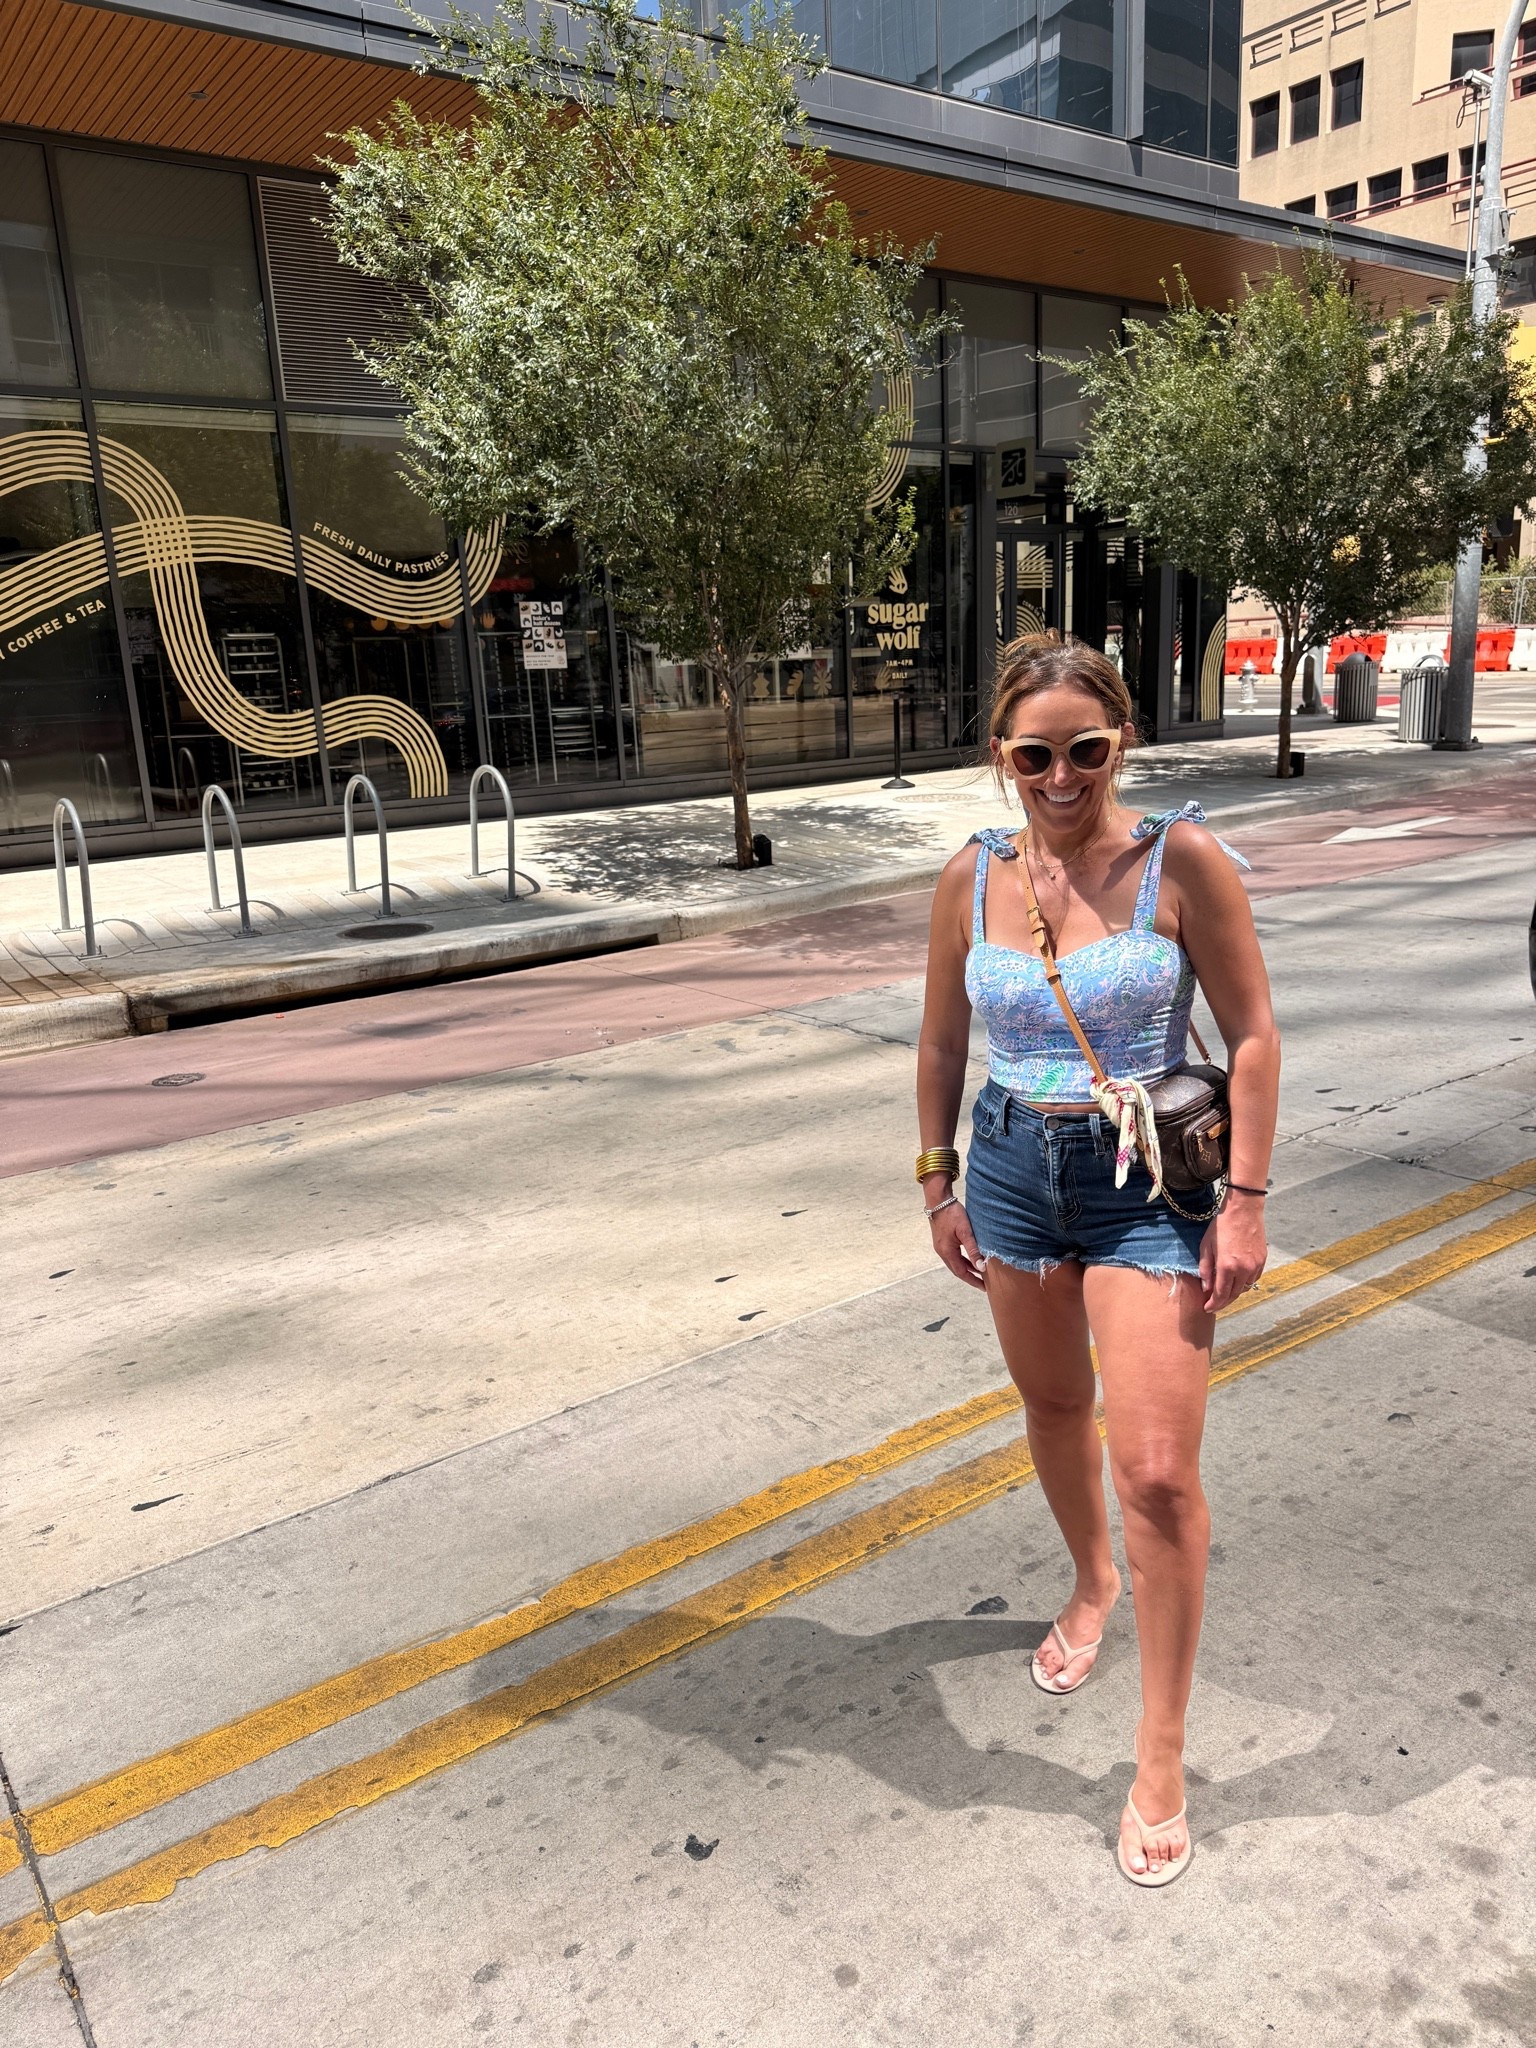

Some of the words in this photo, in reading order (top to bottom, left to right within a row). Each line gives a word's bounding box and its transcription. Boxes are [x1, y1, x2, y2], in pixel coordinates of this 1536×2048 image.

[1004, 505, 1018, 516] 120
[313, 522, 355, 550] FRESH
[357, 545, 391, 569] DAILY
[395, 551, 449, 574] PASTRIES
[7, 617, 63, 653] COFFEE
[65, 612, 77, 624] &
[76, 599, 107, 617] TEA
[867, 602, 930, 630] sugar
[876, 625, 921, 651] wolf
[891, 672, 908, 680] DAILY
